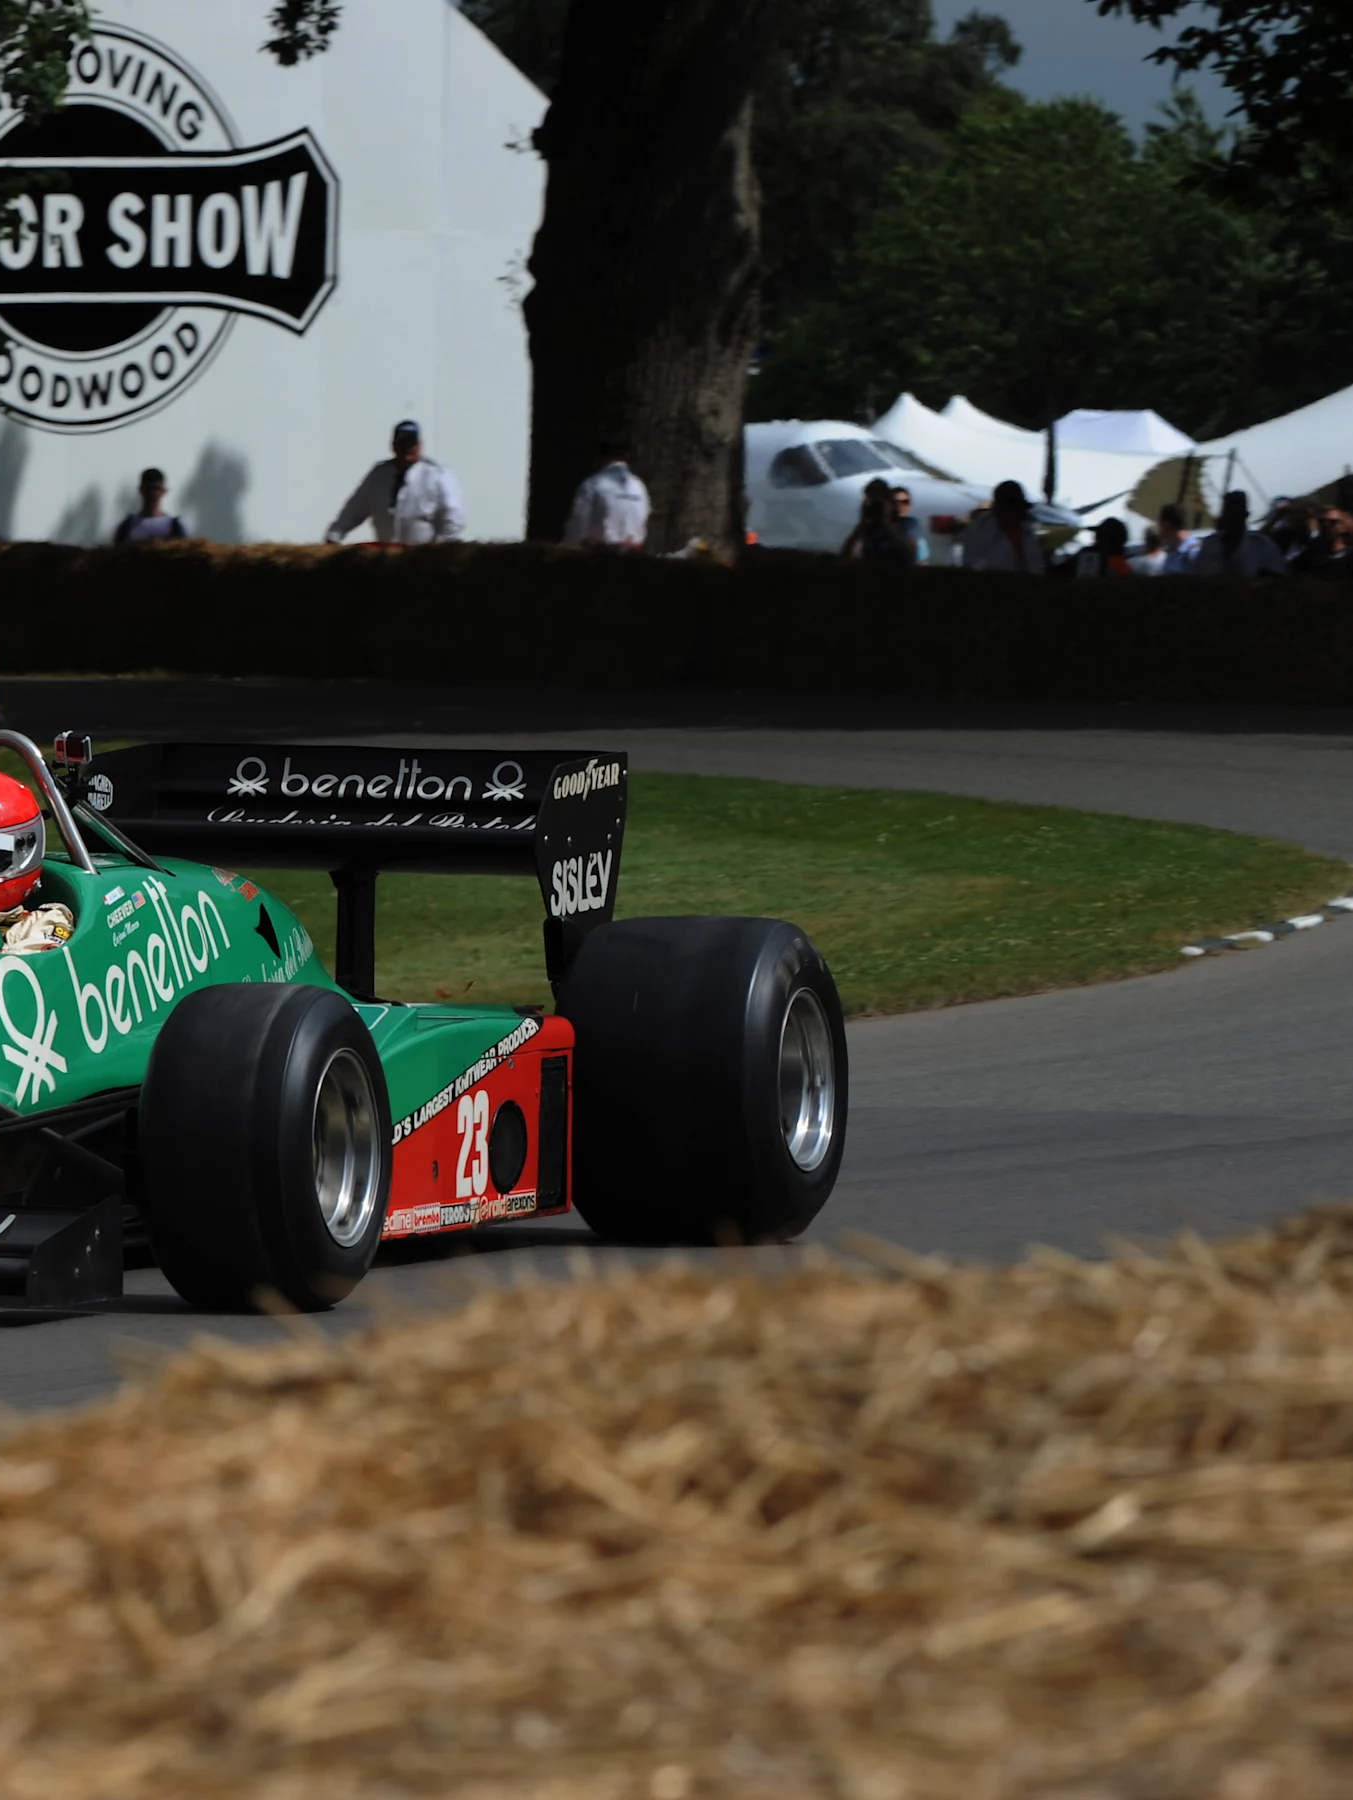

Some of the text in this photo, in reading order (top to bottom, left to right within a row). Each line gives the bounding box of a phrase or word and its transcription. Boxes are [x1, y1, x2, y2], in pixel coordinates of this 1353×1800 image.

[75, 44, 204, 141] OVING
[105, 171, 309, 279] SHOW
[280, 757, 473, 801] benetton
[550, 849, 613, 917] SISLEY
[62, 876, 231, 1054] benetton
[413, 1082, 455, 1130] LARGEST
[455, 1089, 490, 1199] 23
